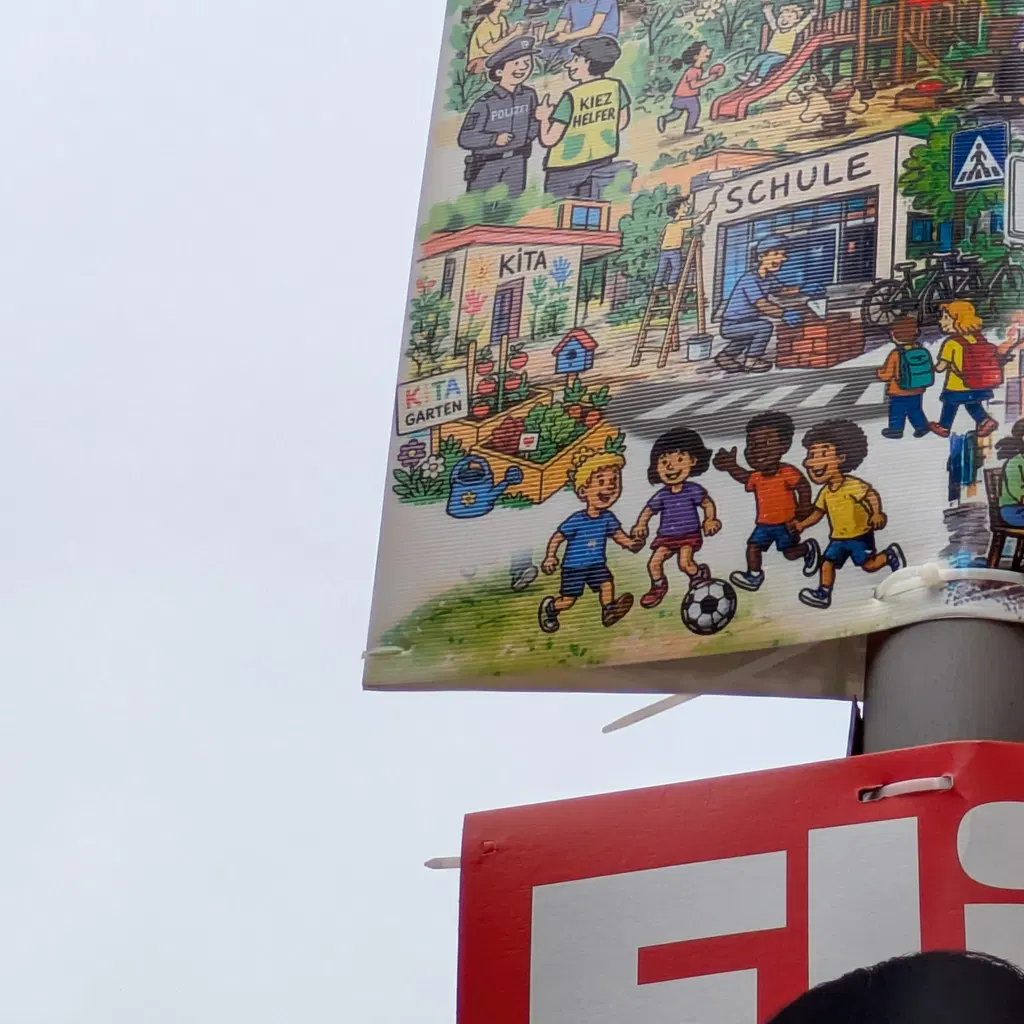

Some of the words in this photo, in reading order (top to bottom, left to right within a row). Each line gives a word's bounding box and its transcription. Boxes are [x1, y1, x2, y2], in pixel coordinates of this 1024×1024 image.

[580, 92, 612, 111] KIEZ
[491, 104, 529, 121] POLIZEI
[572, 107, 615, 128] HELFER
[725, 152, 871, 214] SCHULE
[405, 400, 462, 426] GARTEN
